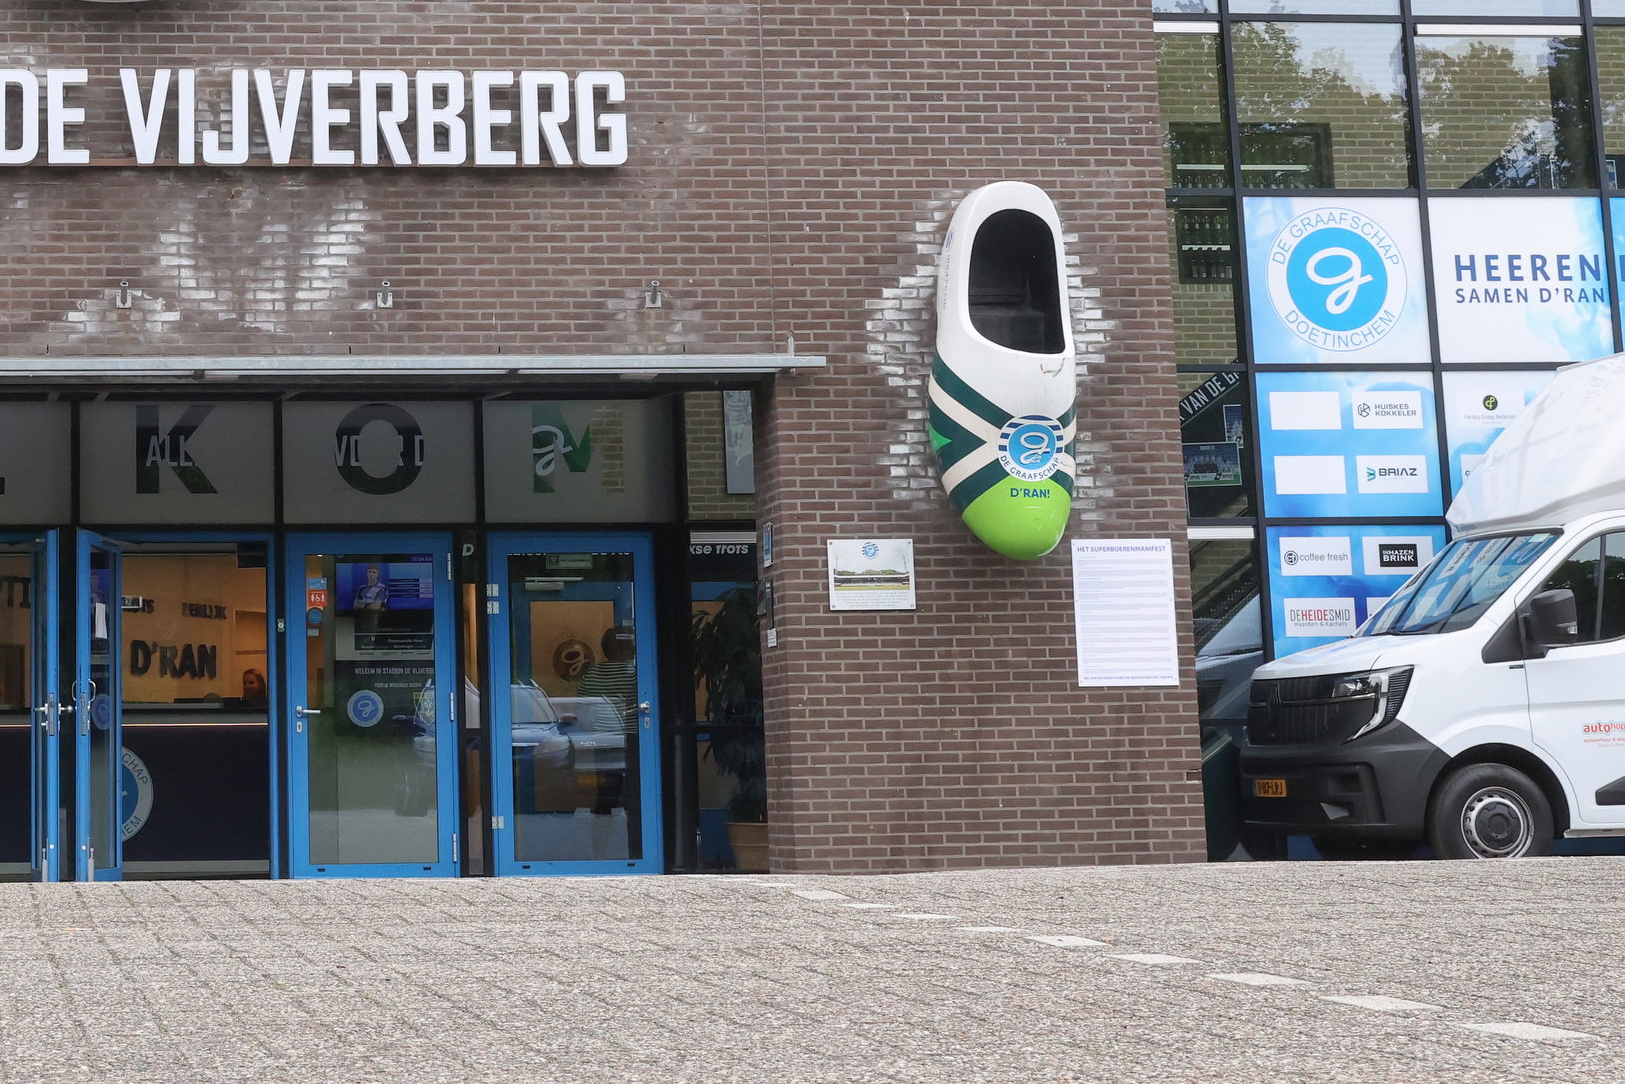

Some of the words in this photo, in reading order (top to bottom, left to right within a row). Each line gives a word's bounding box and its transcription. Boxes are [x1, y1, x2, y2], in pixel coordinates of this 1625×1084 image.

[119, 67, 629, 167] VIJVERBERG
[1272, 239, 1292, 265] DE
[1289, 212, 1400, 265] GRAAFSCHAP
[1454, 254, 1601, 282] HEEREN
[1456, 287, 1528, 303] SAMEN
[1539, 287, 1605, 303] D'RAN
[1285, 309, 1395, 348] DOETINCHEM
[1180, 389, 1209, 415] VAN
[1205, 376, 1226, 398] DE
[1000, 455, 1011, 468] DE
[1010, 457, 1060, 480] GRAAFSCHAP
[1378, 467, 1418, 477] BRIAZ
[1010, 488, 1050, 498] D'RAN!
[1299, 553, 1325, 561] coffee
[1327, 553, 1348, 561] fresh
